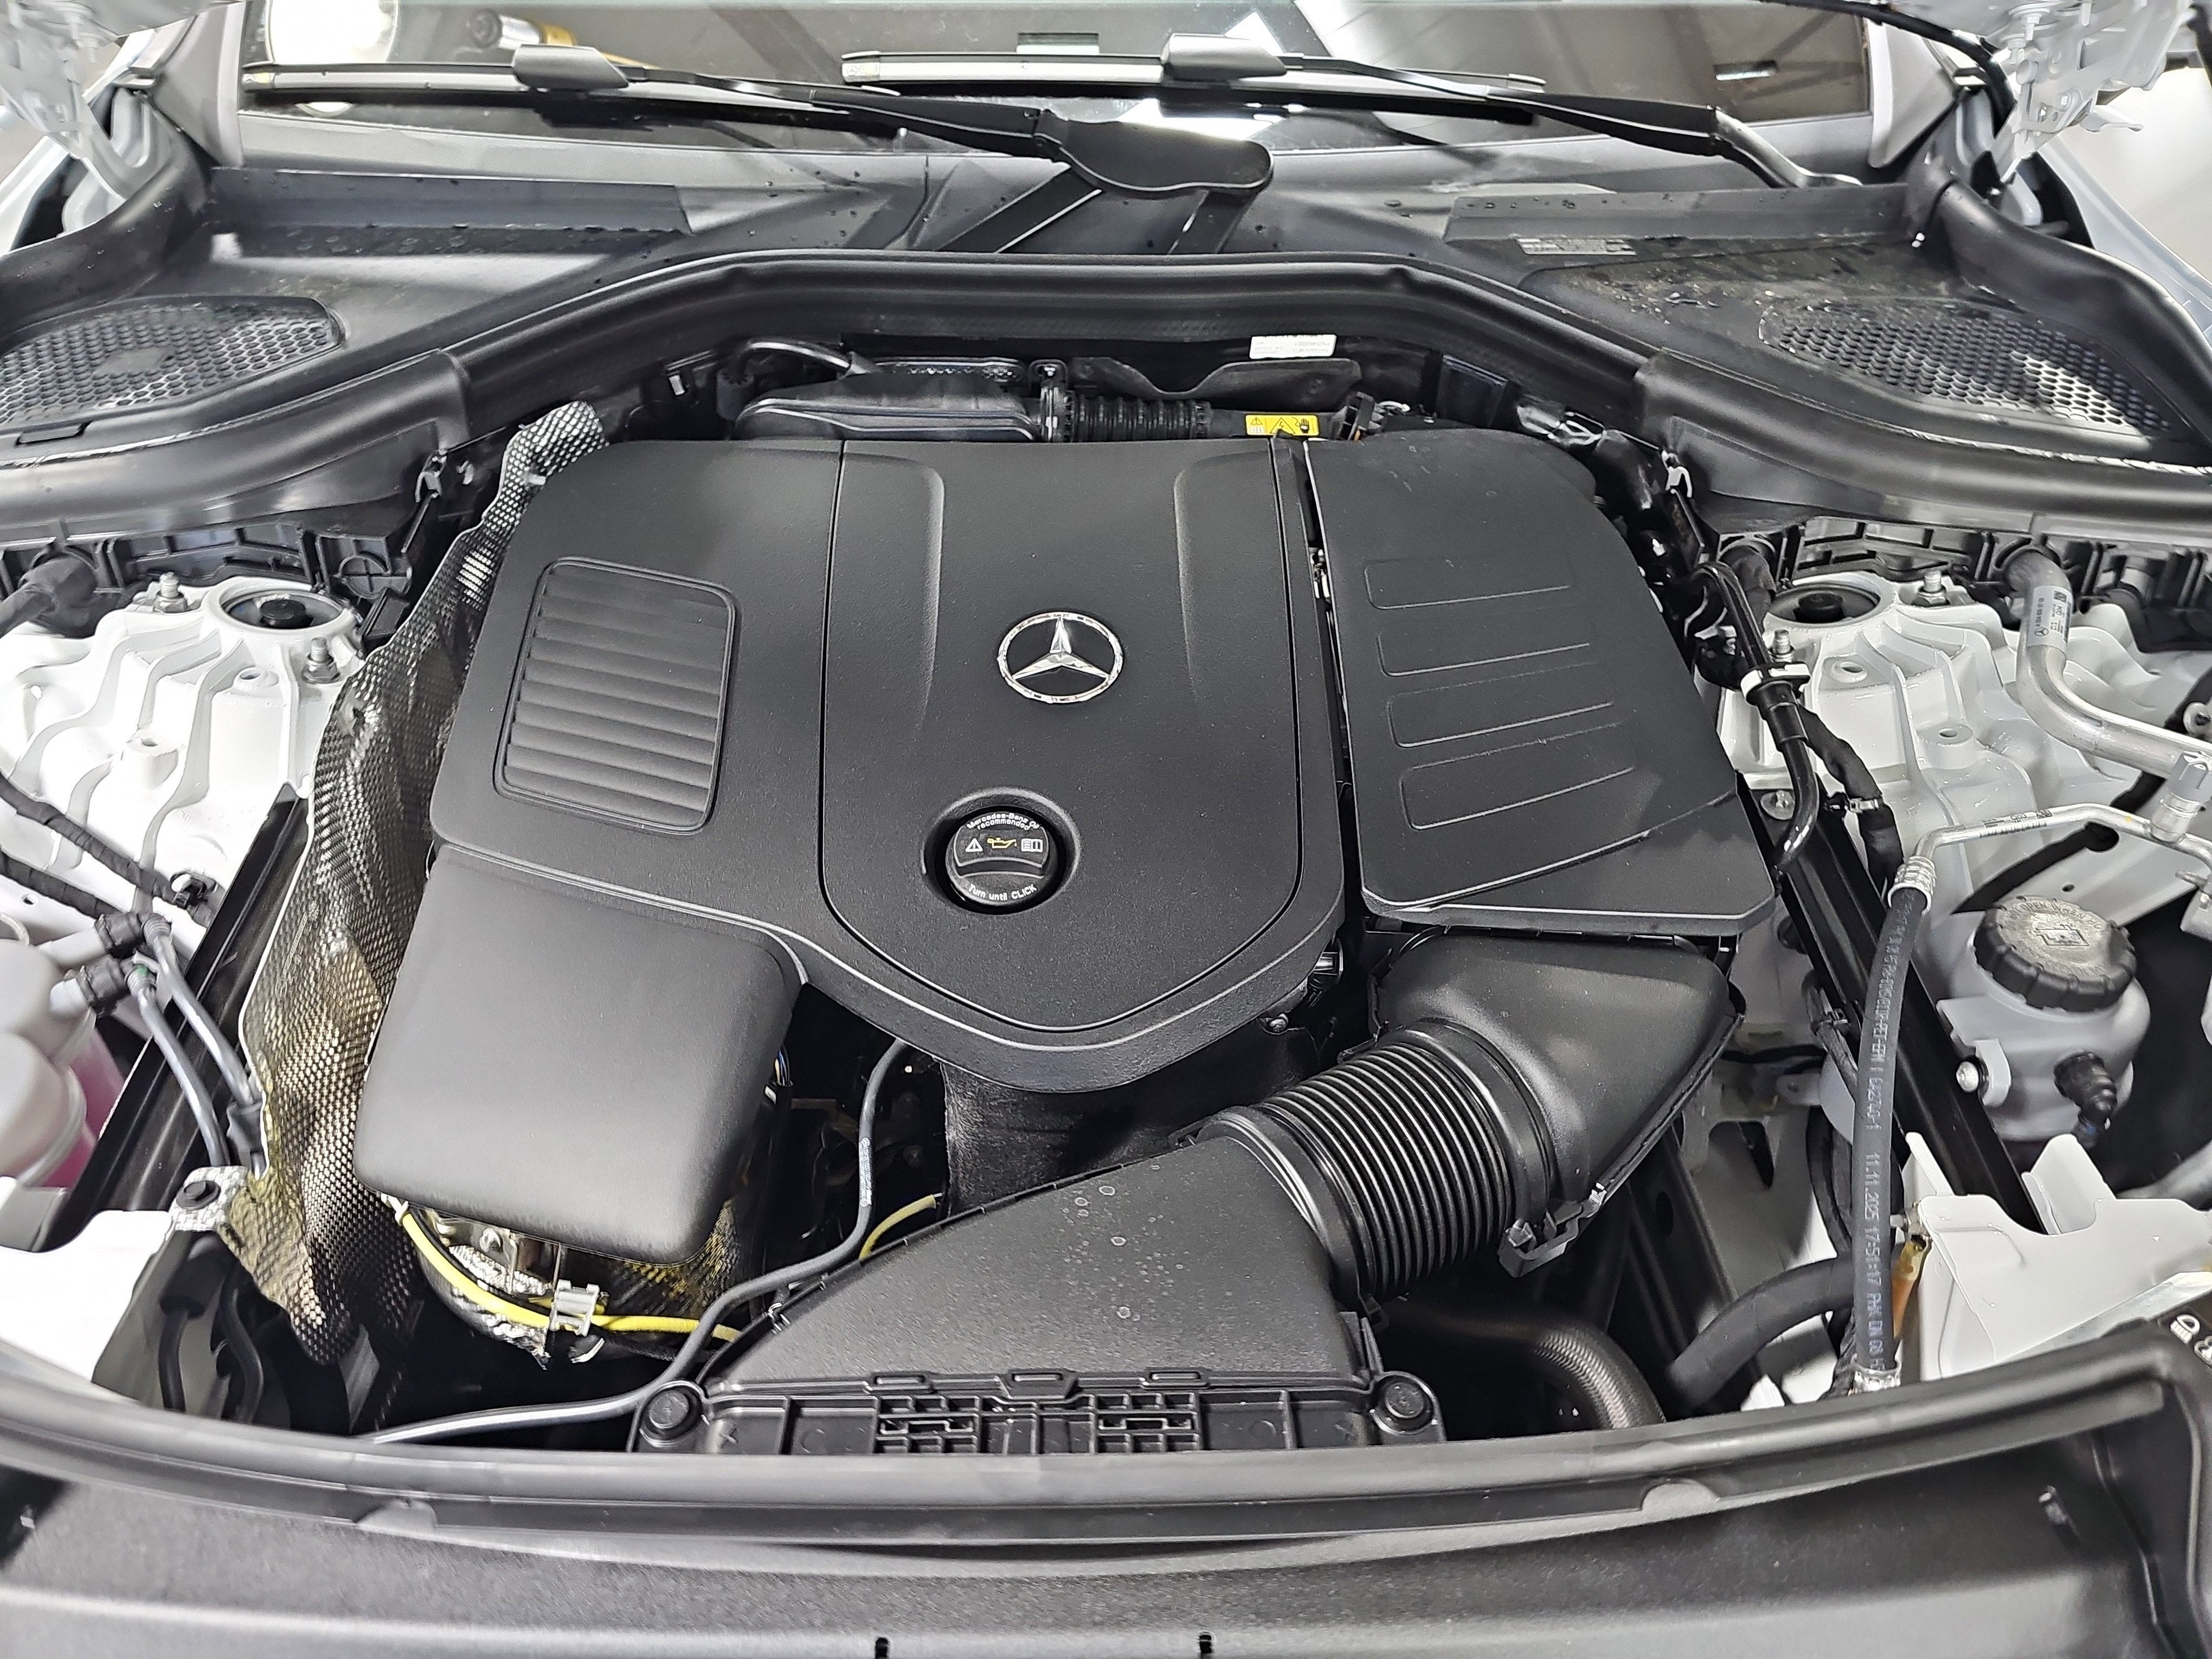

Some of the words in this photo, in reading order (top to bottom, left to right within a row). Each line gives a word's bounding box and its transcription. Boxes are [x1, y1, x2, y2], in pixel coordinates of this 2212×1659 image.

[967, 813, 1029, 828] Mercedes-Benz
[976, 818, 1031, 831] recommended
[968, 884, 986, 898] Turn
[989, 892, 1008, 901] until
[1011, 884, 1038, 899] CLICK
[2020, 902, 2049, 911] OPEN
[1864, 1152, 1881, 1220] 11.11.2025
